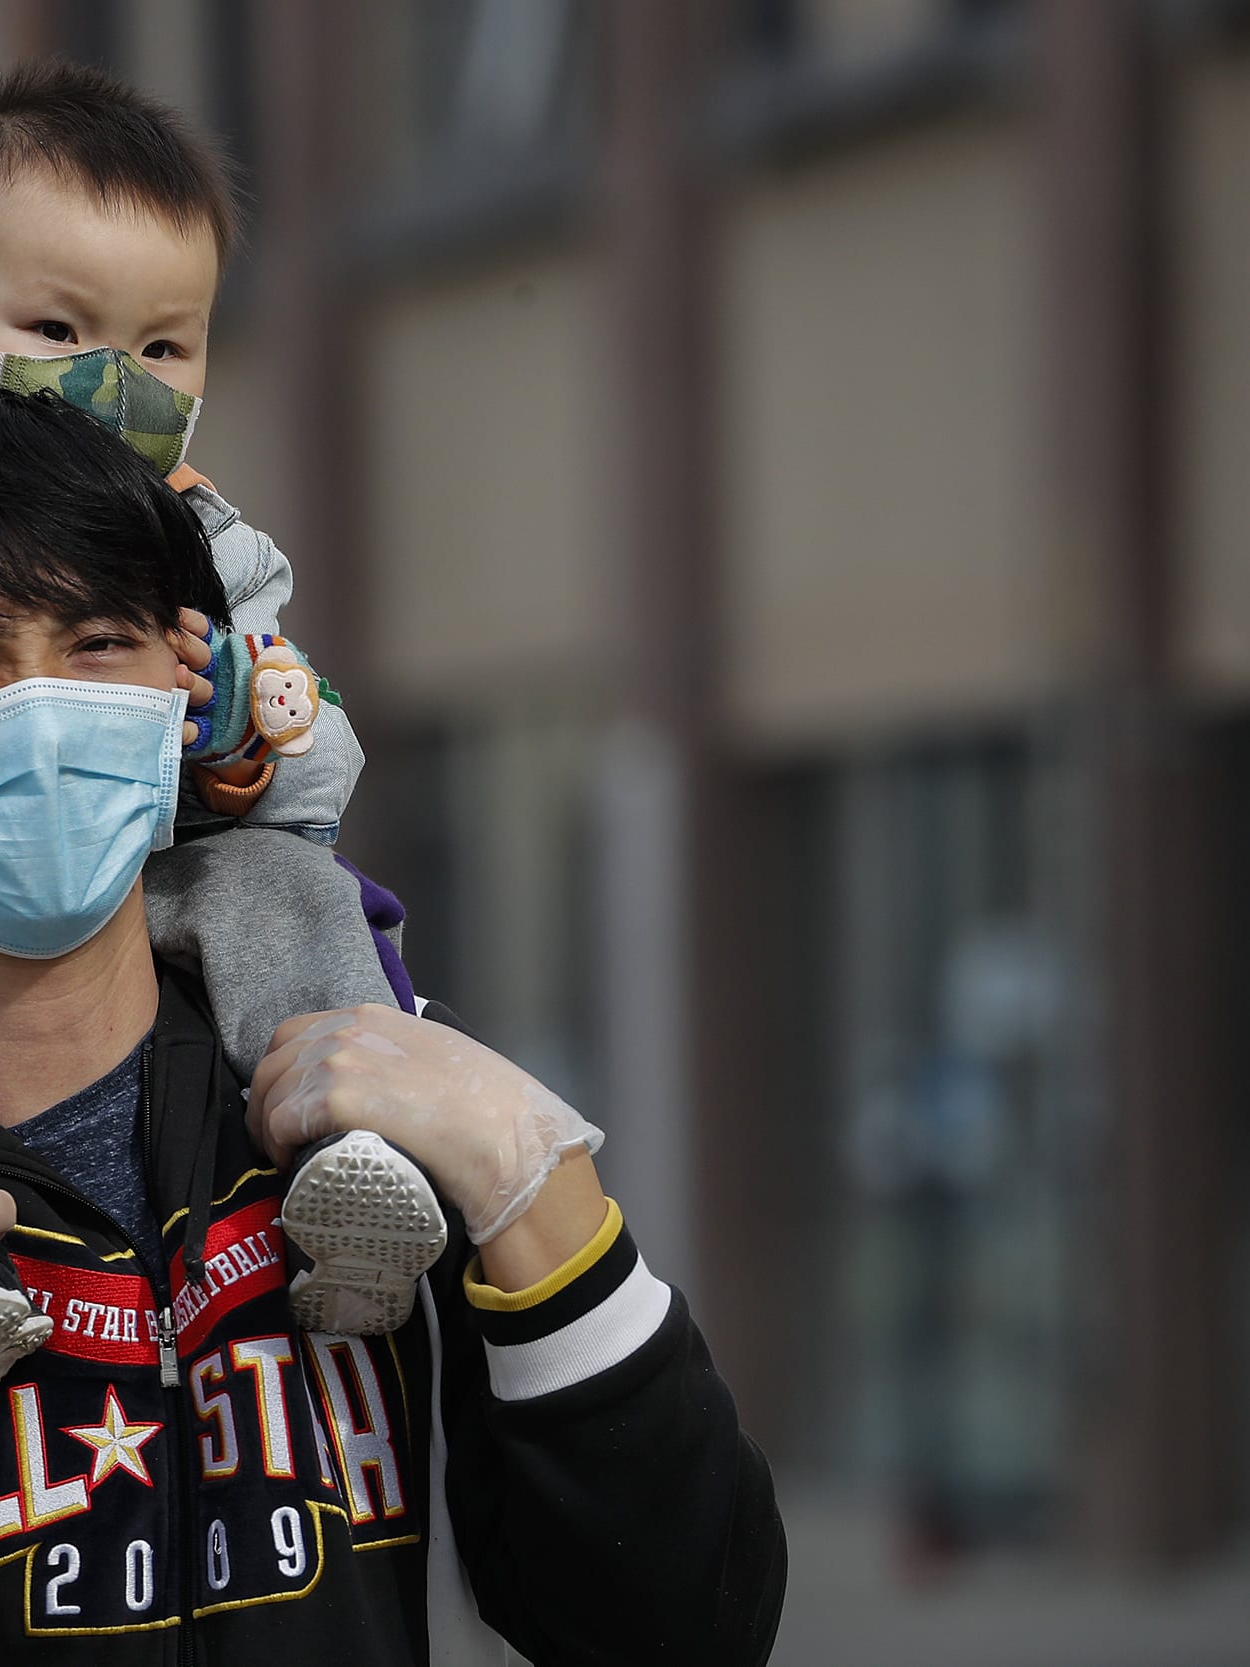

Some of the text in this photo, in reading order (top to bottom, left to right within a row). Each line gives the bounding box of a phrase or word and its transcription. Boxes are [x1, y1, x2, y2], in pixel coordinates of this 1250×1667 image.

[62, 1230, 281, 1344] STAR BSKETBALL
[189, 1332, 407, 1526] STR
